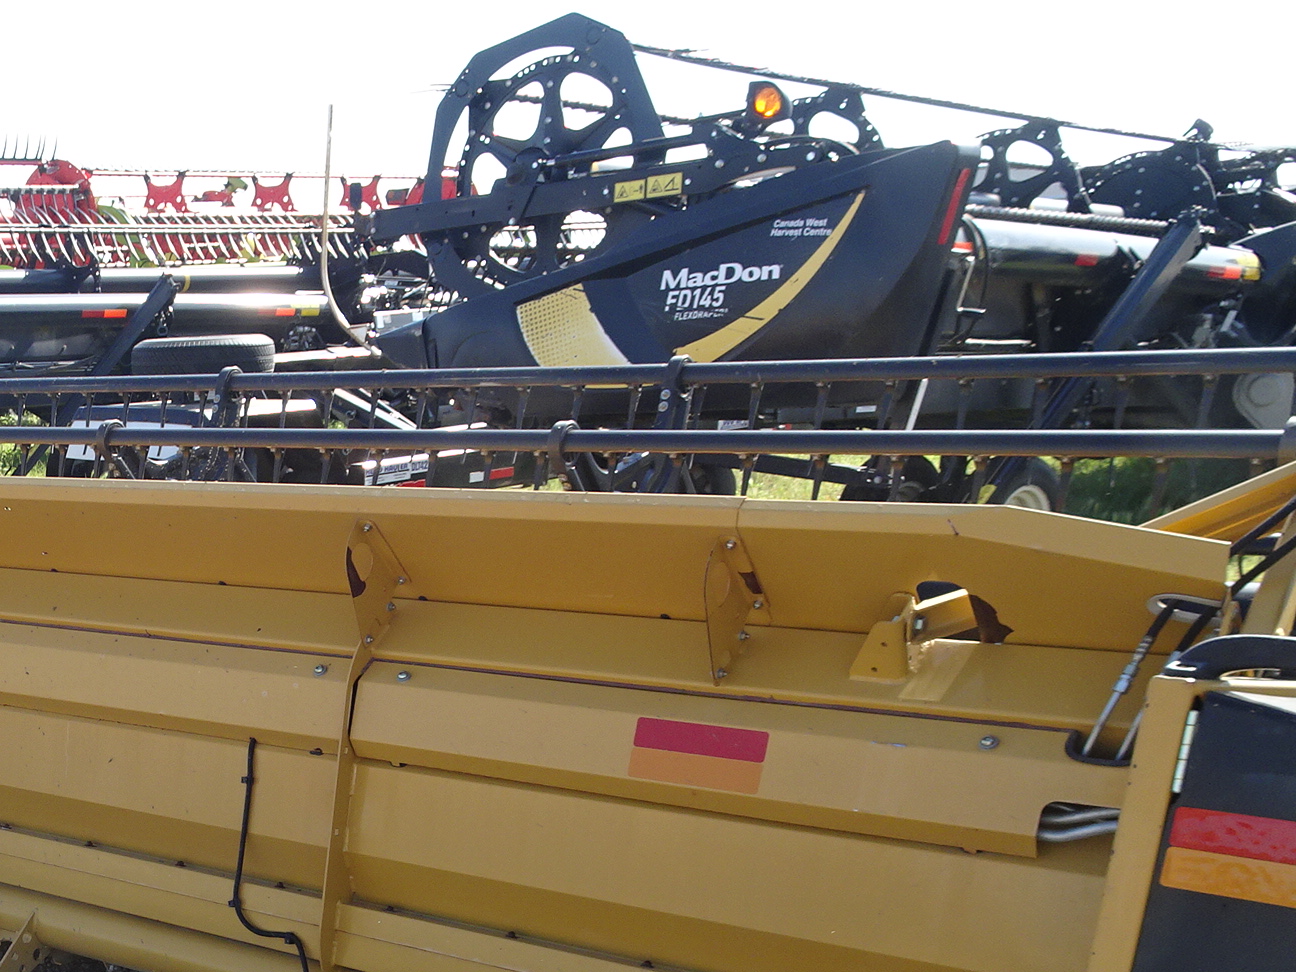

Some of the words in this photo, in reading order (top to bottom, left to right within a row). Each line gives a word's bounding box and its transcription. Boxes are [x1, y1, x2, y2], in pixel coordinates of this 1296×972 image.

[774, 218, 804, 228] Canada
[806, 218, 828, 227] West
[770, 228, 802, 237] Harvest
[803, 228, 832, 236] Centre
[660, 263, 781, 290] MacDon
[665, 286, 726, 311] FD145
